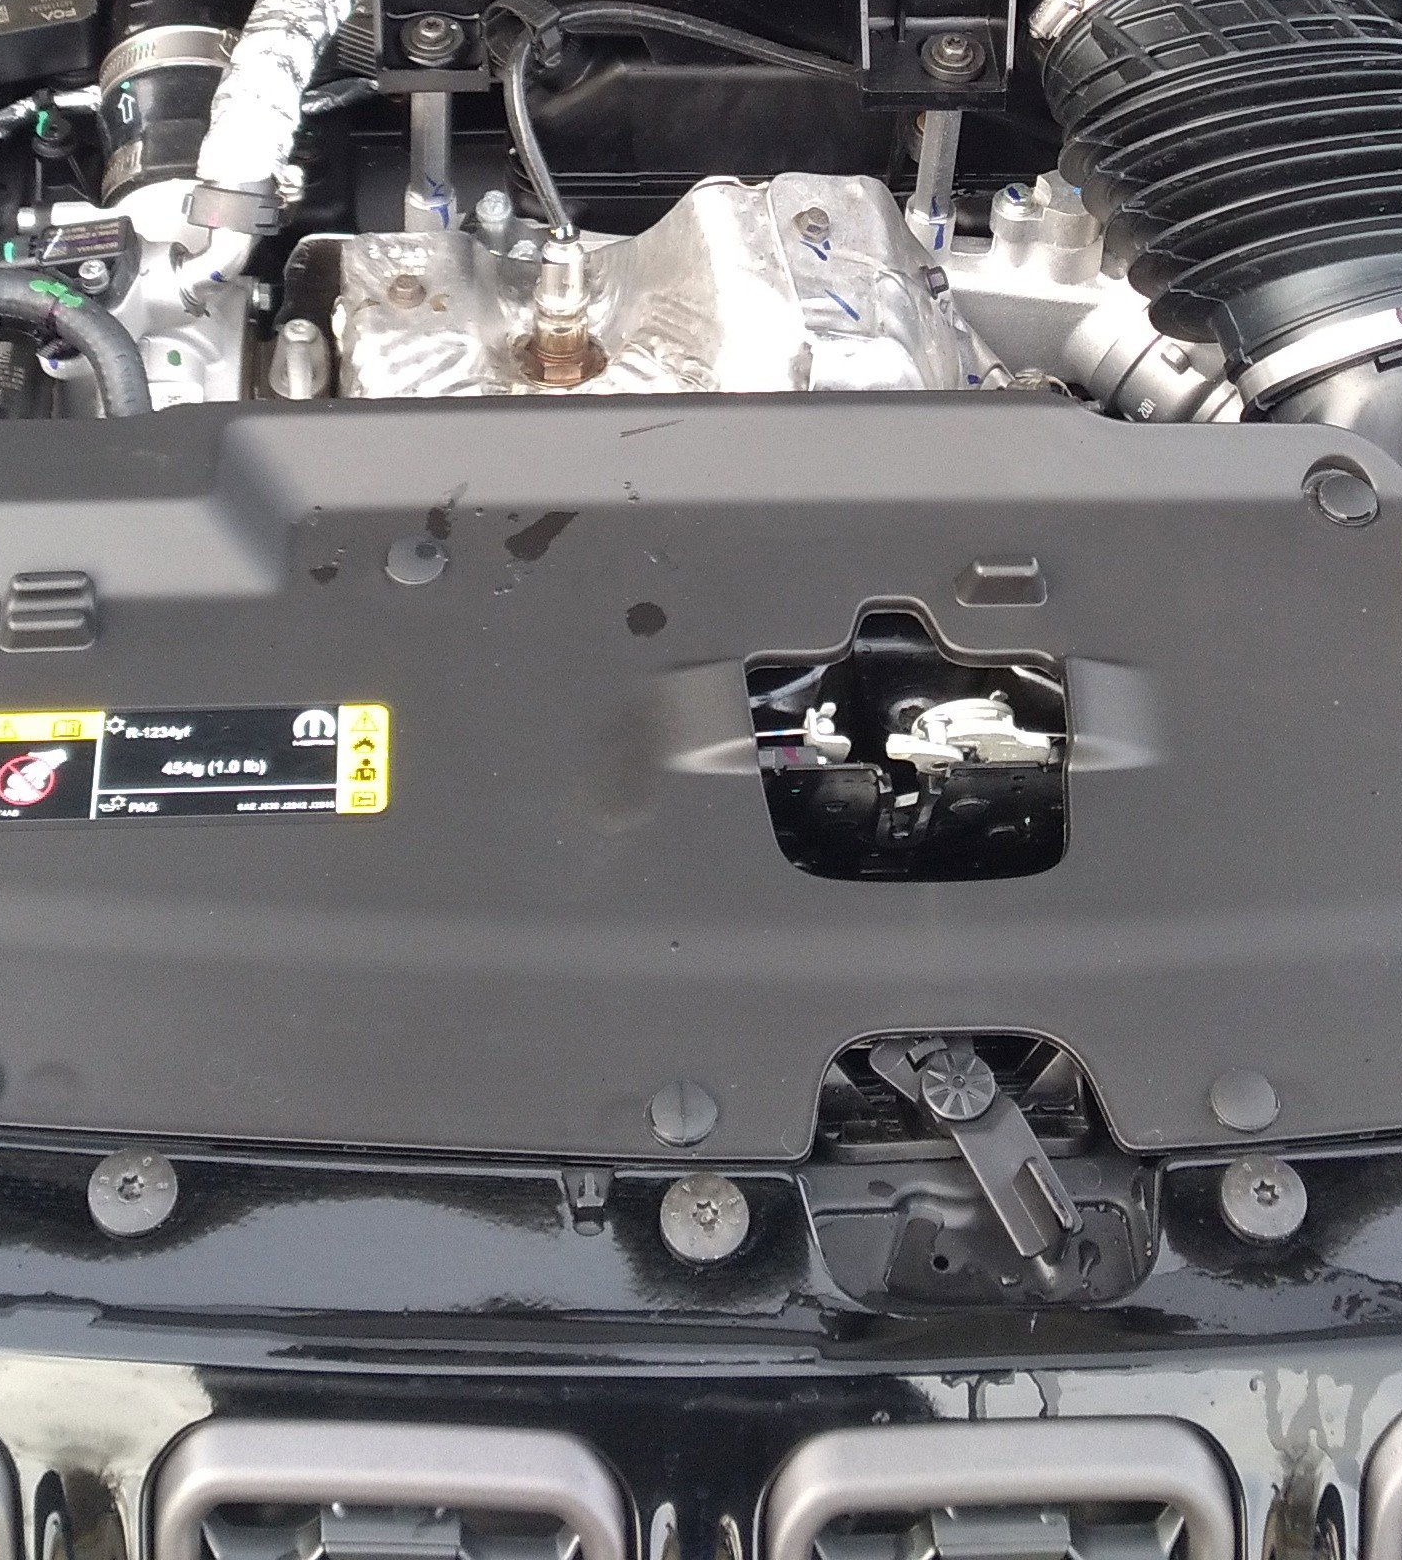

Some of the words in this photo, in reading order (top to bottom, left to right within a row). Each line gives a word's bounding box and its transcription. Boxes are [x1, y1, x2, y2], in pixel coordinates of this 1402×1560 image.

[161, 760, 205, 778] 454g
[207, 760, 240, 778] (1.0
[243, 759, 268, 776] lb)
[128, 801, 159, 813] PAG
